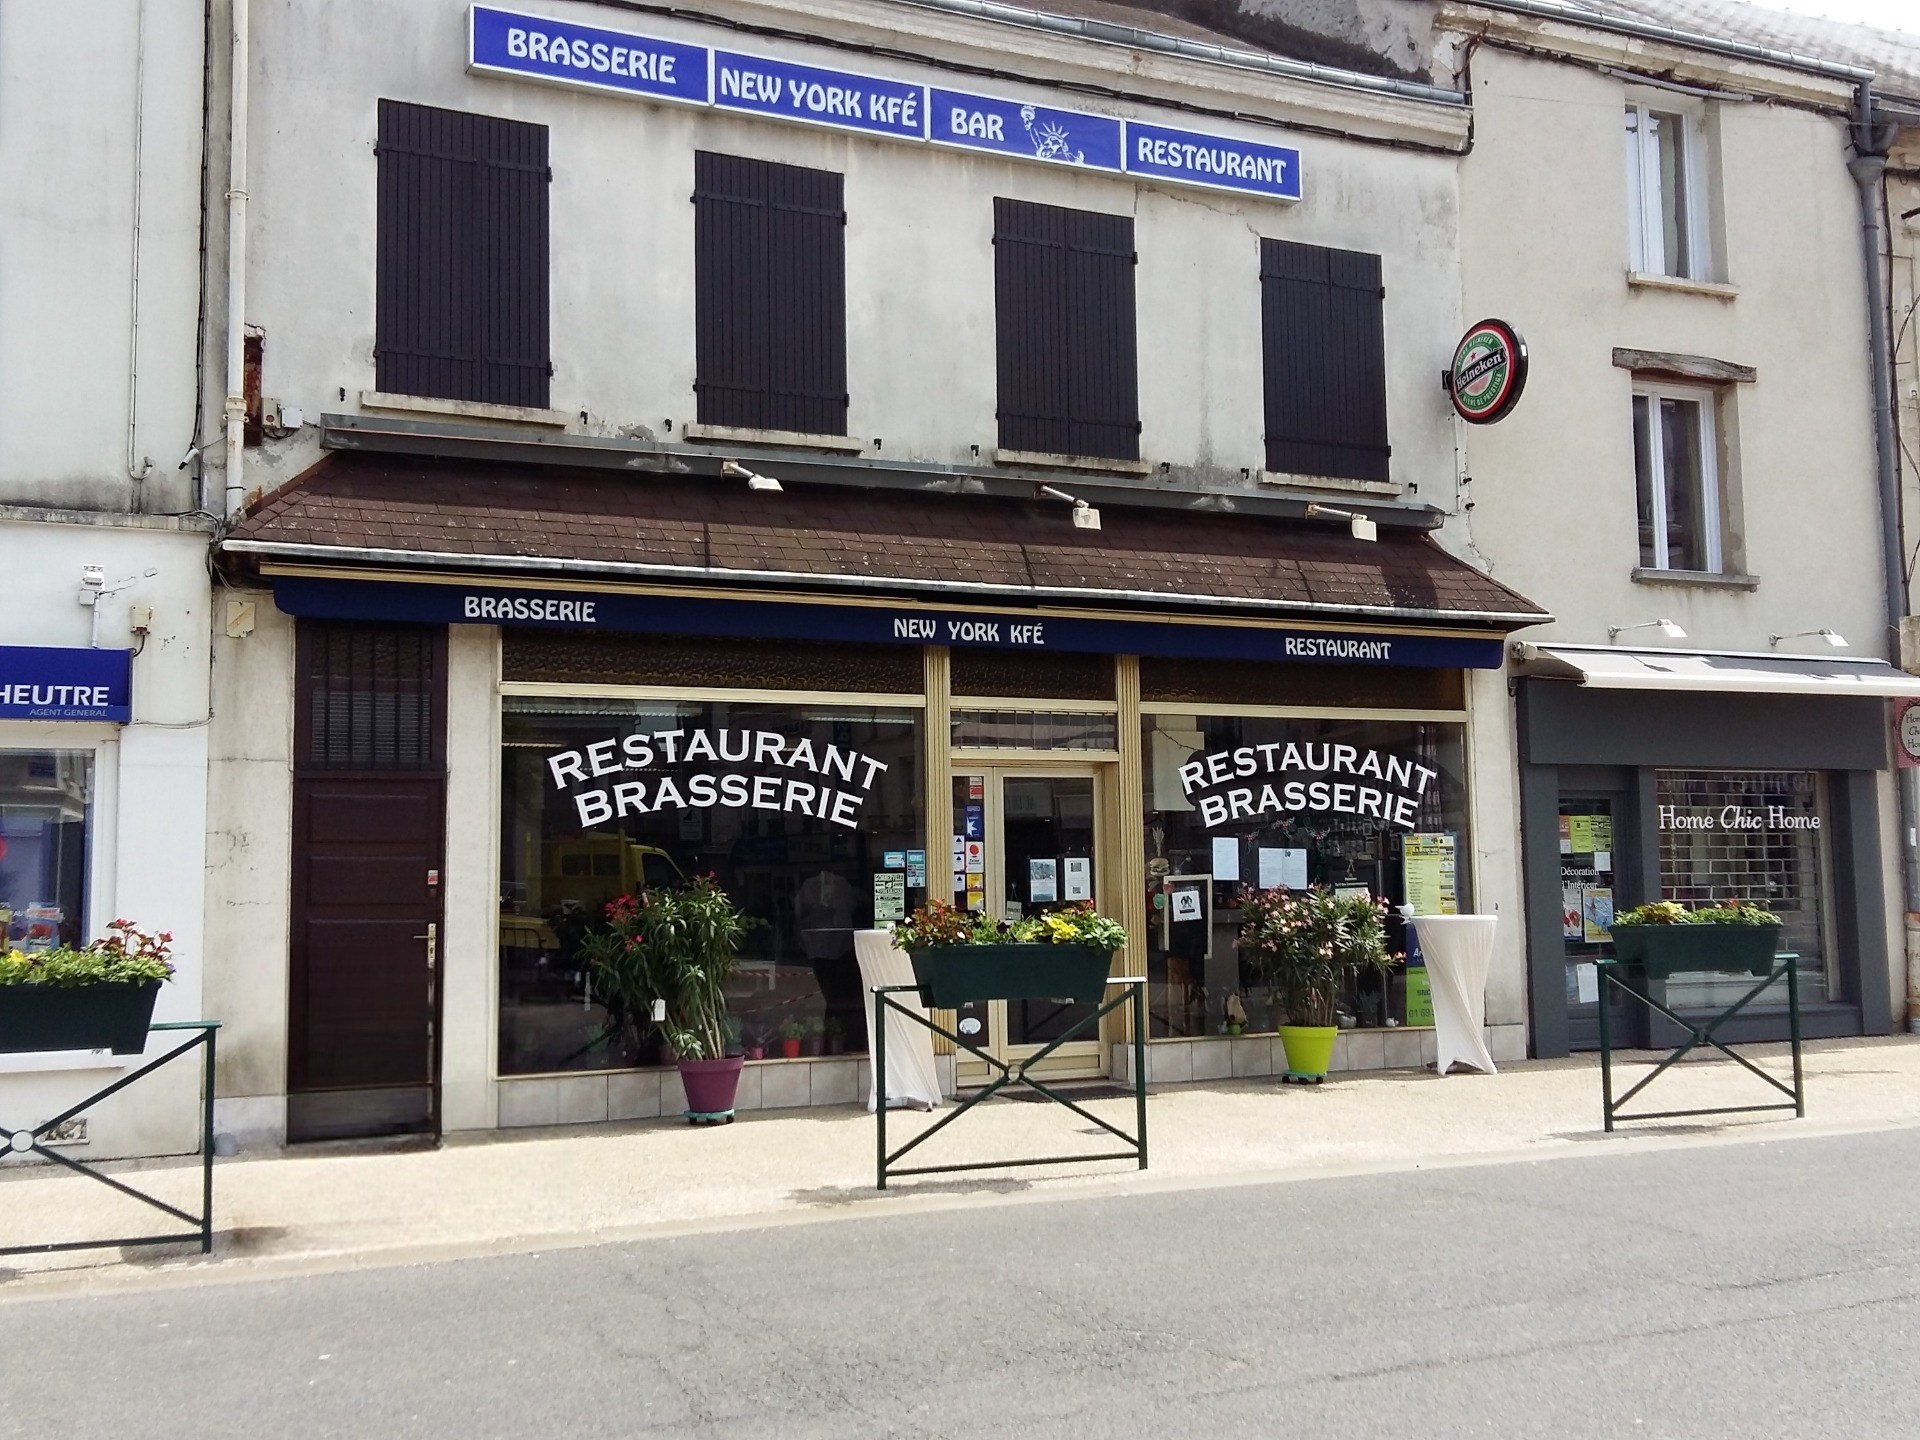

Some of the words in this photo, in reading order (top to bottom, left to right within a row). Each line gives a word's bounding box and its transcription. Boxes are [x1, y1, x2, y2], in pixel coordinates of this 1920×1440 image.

[508, 28, 677, 84] BRASSERIE
[721, 68, 781, 103] NEW
[789, 80, 862, 119] YORK
[869, 92, 918, 128] KFÉ
[952, 107, 1005, 142] BAR
[1138, 137, 1287, 184] RESTAURANT
[1456, 353, 1502, 390] Heineken
[1483, 372, 1503, 402] PRESTIGE
[464, 596, 596, 623] BRASSERIE
[894, 618, 936, 639] NEW
[948, 621, 1000, 642] YORK
[1010, 624, 1045, 645] KFÉ
[1285, 637, 1392, 660] RESTAURANT
[29, 708, 62, 717] AGENT
[63, 708, 108, 718] GENERAL
[547, 728, 888, 790] RESTAURANT
[1178, 742, 1437, 796] RESTAURANT
[574, 774, 863, 829] BRASSERIE
[1199, 781, 1419, 829] BRASSERIE
[1658, 804, 1714, 830] Home
[1720, 804, 1763, 830] Chic
[1768, 804, 1821, 830] Home
[1560, 866, 1600, 877] Décoration
